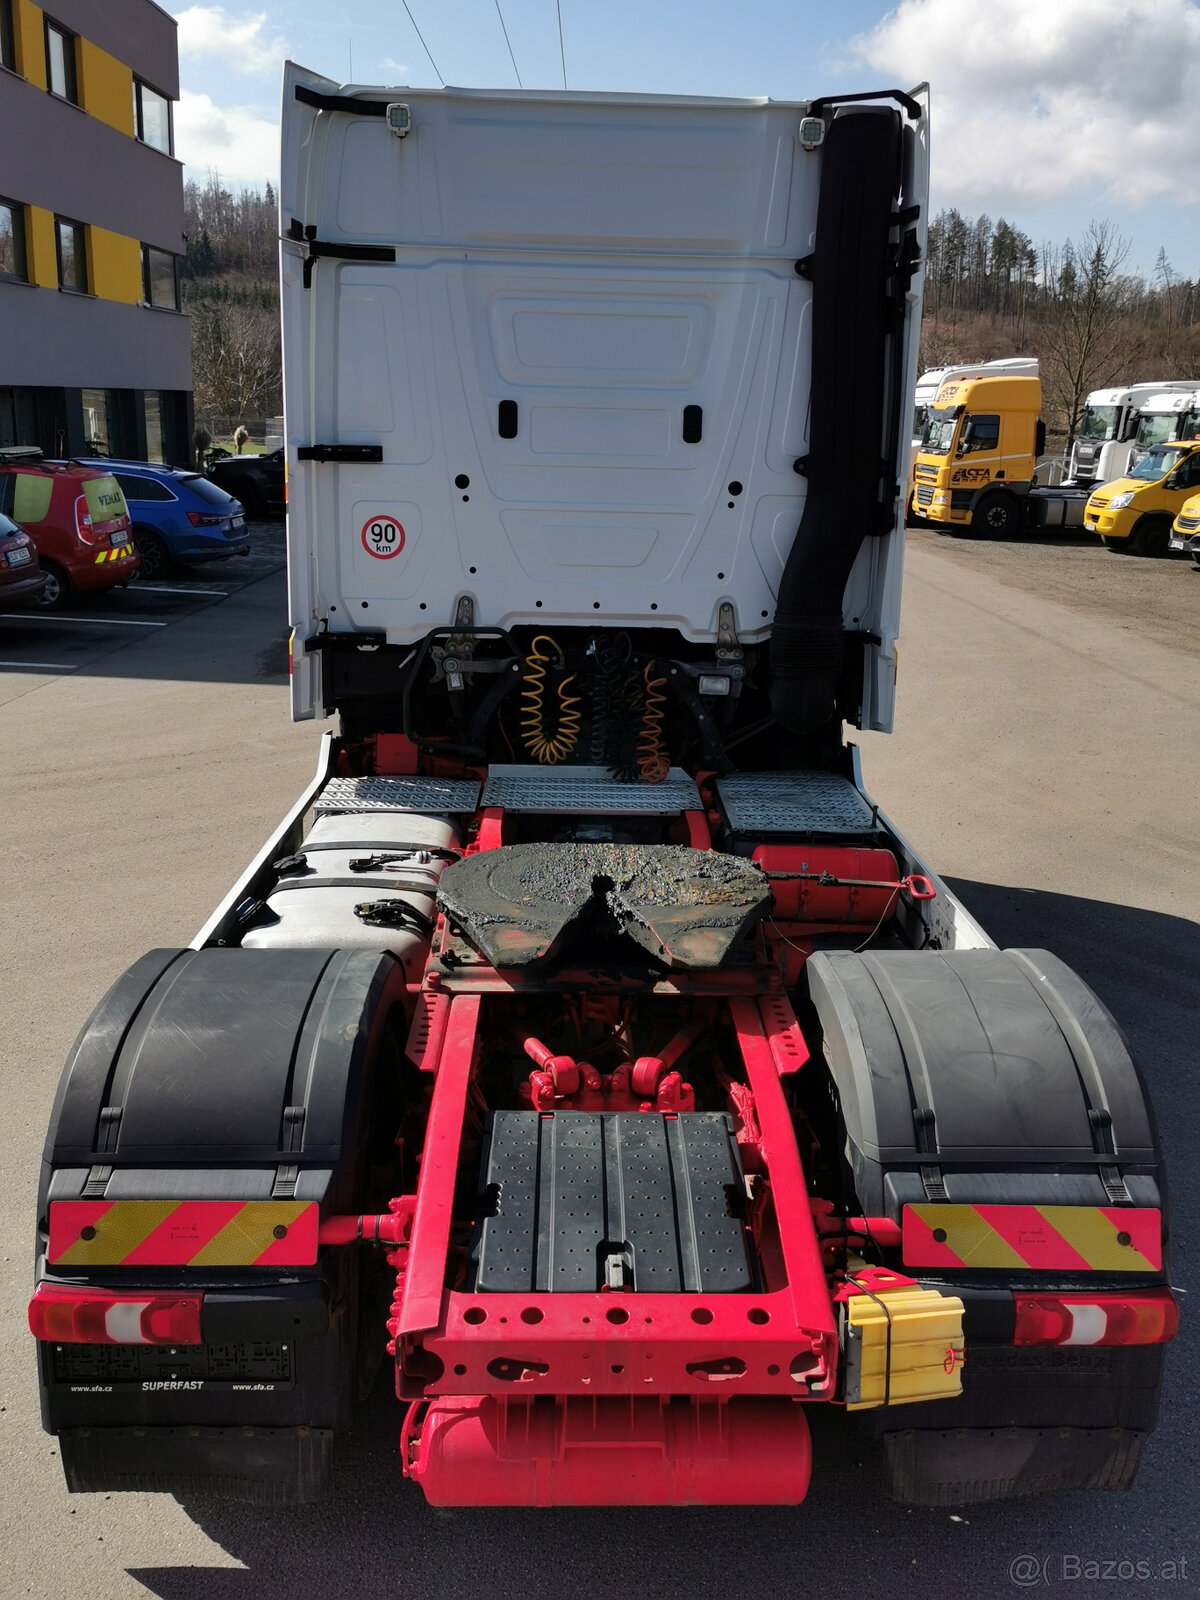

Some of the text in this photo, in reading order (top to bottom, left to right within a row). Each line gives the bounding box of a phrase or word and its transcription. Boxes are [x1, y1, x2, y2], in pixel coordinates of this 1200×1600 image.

[371, 523, 395, 543] 90
[376, 544, 391, 552] km
[142, 1381, 204, 1391] SUPERFAST
[232, 1383, 275, 1391] www.sfa.cz
